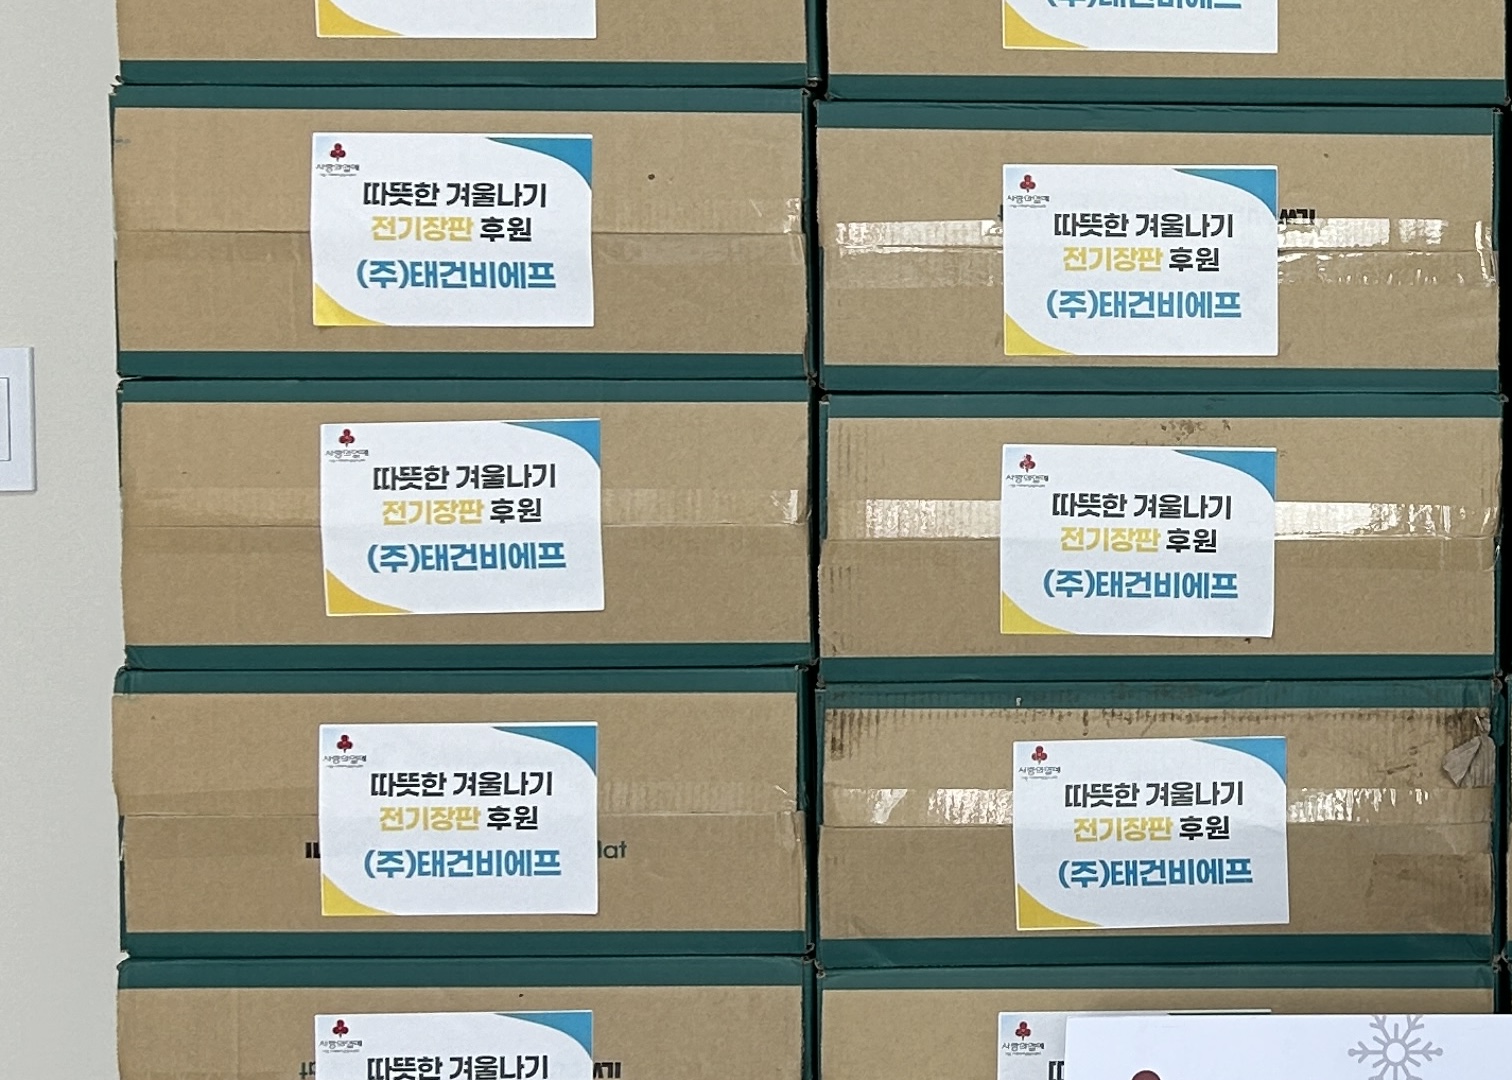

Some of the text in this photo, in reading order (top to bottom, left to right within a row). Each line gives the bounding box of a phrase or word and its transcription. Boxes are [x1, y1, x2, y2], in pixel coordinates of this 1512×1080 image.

[363, 181, 547, 208] 따뜻한 겨울나기
[371, 216, 532, 243] 전기장판 후원
[1054, 212, 1233, 238] 따뜻한 겨울나기
[1062, 246, 1220, 272] 전기장판 후원
[357, 259, 556, 289] (주)태건비에프
[1046, 290, 1242, 319] (주)태건비에프
[373, 463, 556, 491] 따뜻한 겨울나기
[381, 497, 542, 525] 전기장판 후원
[1052, 492, 1232, 520] 따뜻한 겨울나기
[1060, 527, 1217, 554] 전기장판 후원
[367, 541, 567, 572] (주)태건비에프
[1043, 569, 1238, 599] (주)태건비에프
[370, 771, 553, 798] 따뜻한 겨울나기
[1064, 781, 1243, 808] 따뜻한 겨울나기
[379, 805, 539, 831] 전기장판 후원
[1074, 815, 1230, 842] 전기장판 후원
[364, 848, 562, 879] (주)태건비에프
[1058, 857, 1252, 888] (주)태건비에프
[449, 1054, 548, 1080] 겨울나기
